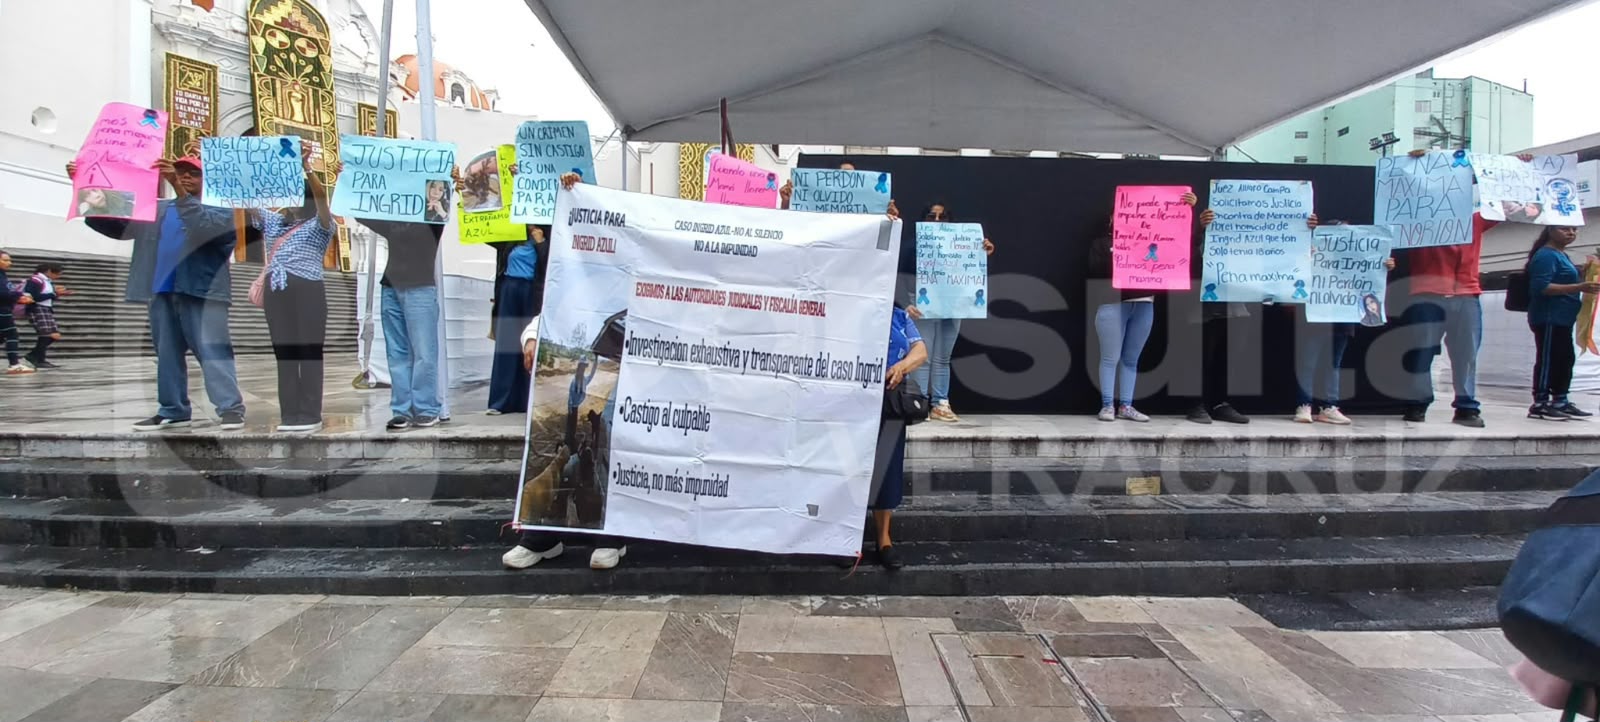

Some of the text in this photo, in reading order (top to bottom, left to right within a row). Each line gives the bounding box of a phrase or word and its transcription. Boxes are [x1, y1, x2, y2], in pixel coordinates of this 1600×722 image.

[178, 110, 206, 122] DE LAS
[182, 119, 203, 128] ALMAS
[520, 126, 575, 140] UN CRIMEN
[202, 137, 271, 152] EXIGIMOS
[520, 143, 585, 158] SIN CASTIGO
[204, 149, 280, 164] JUSTICIA
[352, 143, 454, 174] JUSTICIA
[205, 162, 302, 177] PARA INGRID
[519, 161, 557, 174] ES UNA
[713, 159, 745, 177] Cuando
[1377, 152, 1453, 178] PENA
[205, 175, 304, 188] PENA MAXIMA
[352, 171, 387, 190] PARA
[794, 171, 865, 189] NI PERDON
[1375, 174, 1464, 198] MAXIMA
[206, 188, 240, 198] PARA
[255, 187, 305, 198] ASESINO
[1211, 182, 1234, 194] Juez
[1263, 184, 1291, 194] Campa
[350, 191, 424, 216] INGRID
[517, 191, 555, 206] PARA
[794, 189, 854, 204] NI OLVIDO
[1120, 192, 1134, 209] No
[1270, 197, 1302, 208] Justicia
[514, 206, 528, 217] LA
[1385, 192, 1456, 221] PARA
[604, 210, 626, 228] PARA
[1253, 211, 1265, 220] de
[465, 228, 494, 238] AZUL
[674, 220, 692, 232] CASO
[693, 222, 715, 234] INGRID
[745, 228, 753, 238] AL
[754, 228, 784, 240] SILENCIO
[1276, 220, 1289, 231] de
[572, 234, 596, 251] INGRID
[1208, 234, 1242, 246] Ingrid
[1265, 235, 1280, 244] que
[694, 240, 758, 257] NO A LA IMPUNIDAD
[1313, 253, 1383, 273] Para Ingrid
[635, 282, 826, 317] EXIGIMOS A LAS AUTORIDADES JUDICIALES Y FISCALÍA GENERAL
[628, 330, 884, 389] Investigacion exhaustiva y transparente del caso Ingrid
[623, 396, 711, 436] Castigo al culpable
[616, 462, 730, 501] Justicia, no más impunidad
